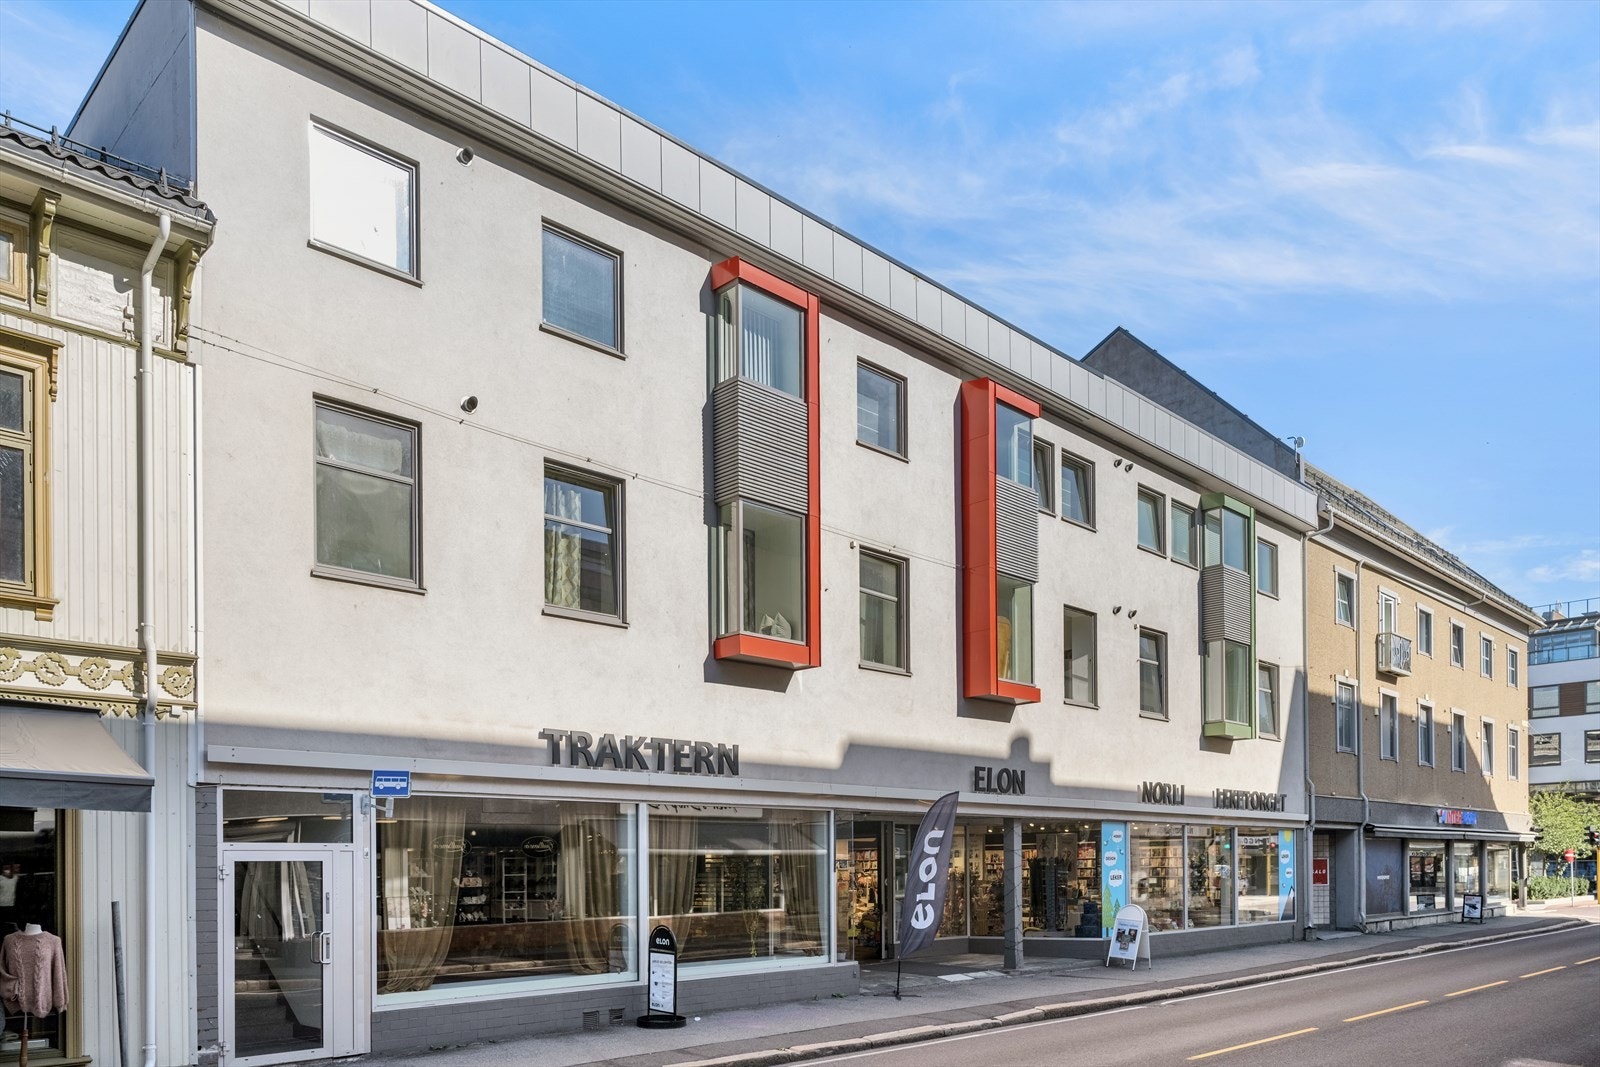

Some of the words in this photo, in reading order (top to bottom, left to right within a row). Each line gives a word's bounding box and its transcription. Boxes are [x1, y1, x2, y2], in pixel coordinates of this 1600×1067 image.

[542, 728, 739, 776] TRAKTERN
[974, 766, 1026, 795] ELON
[1141, 781, 1185, 806] NORLI
